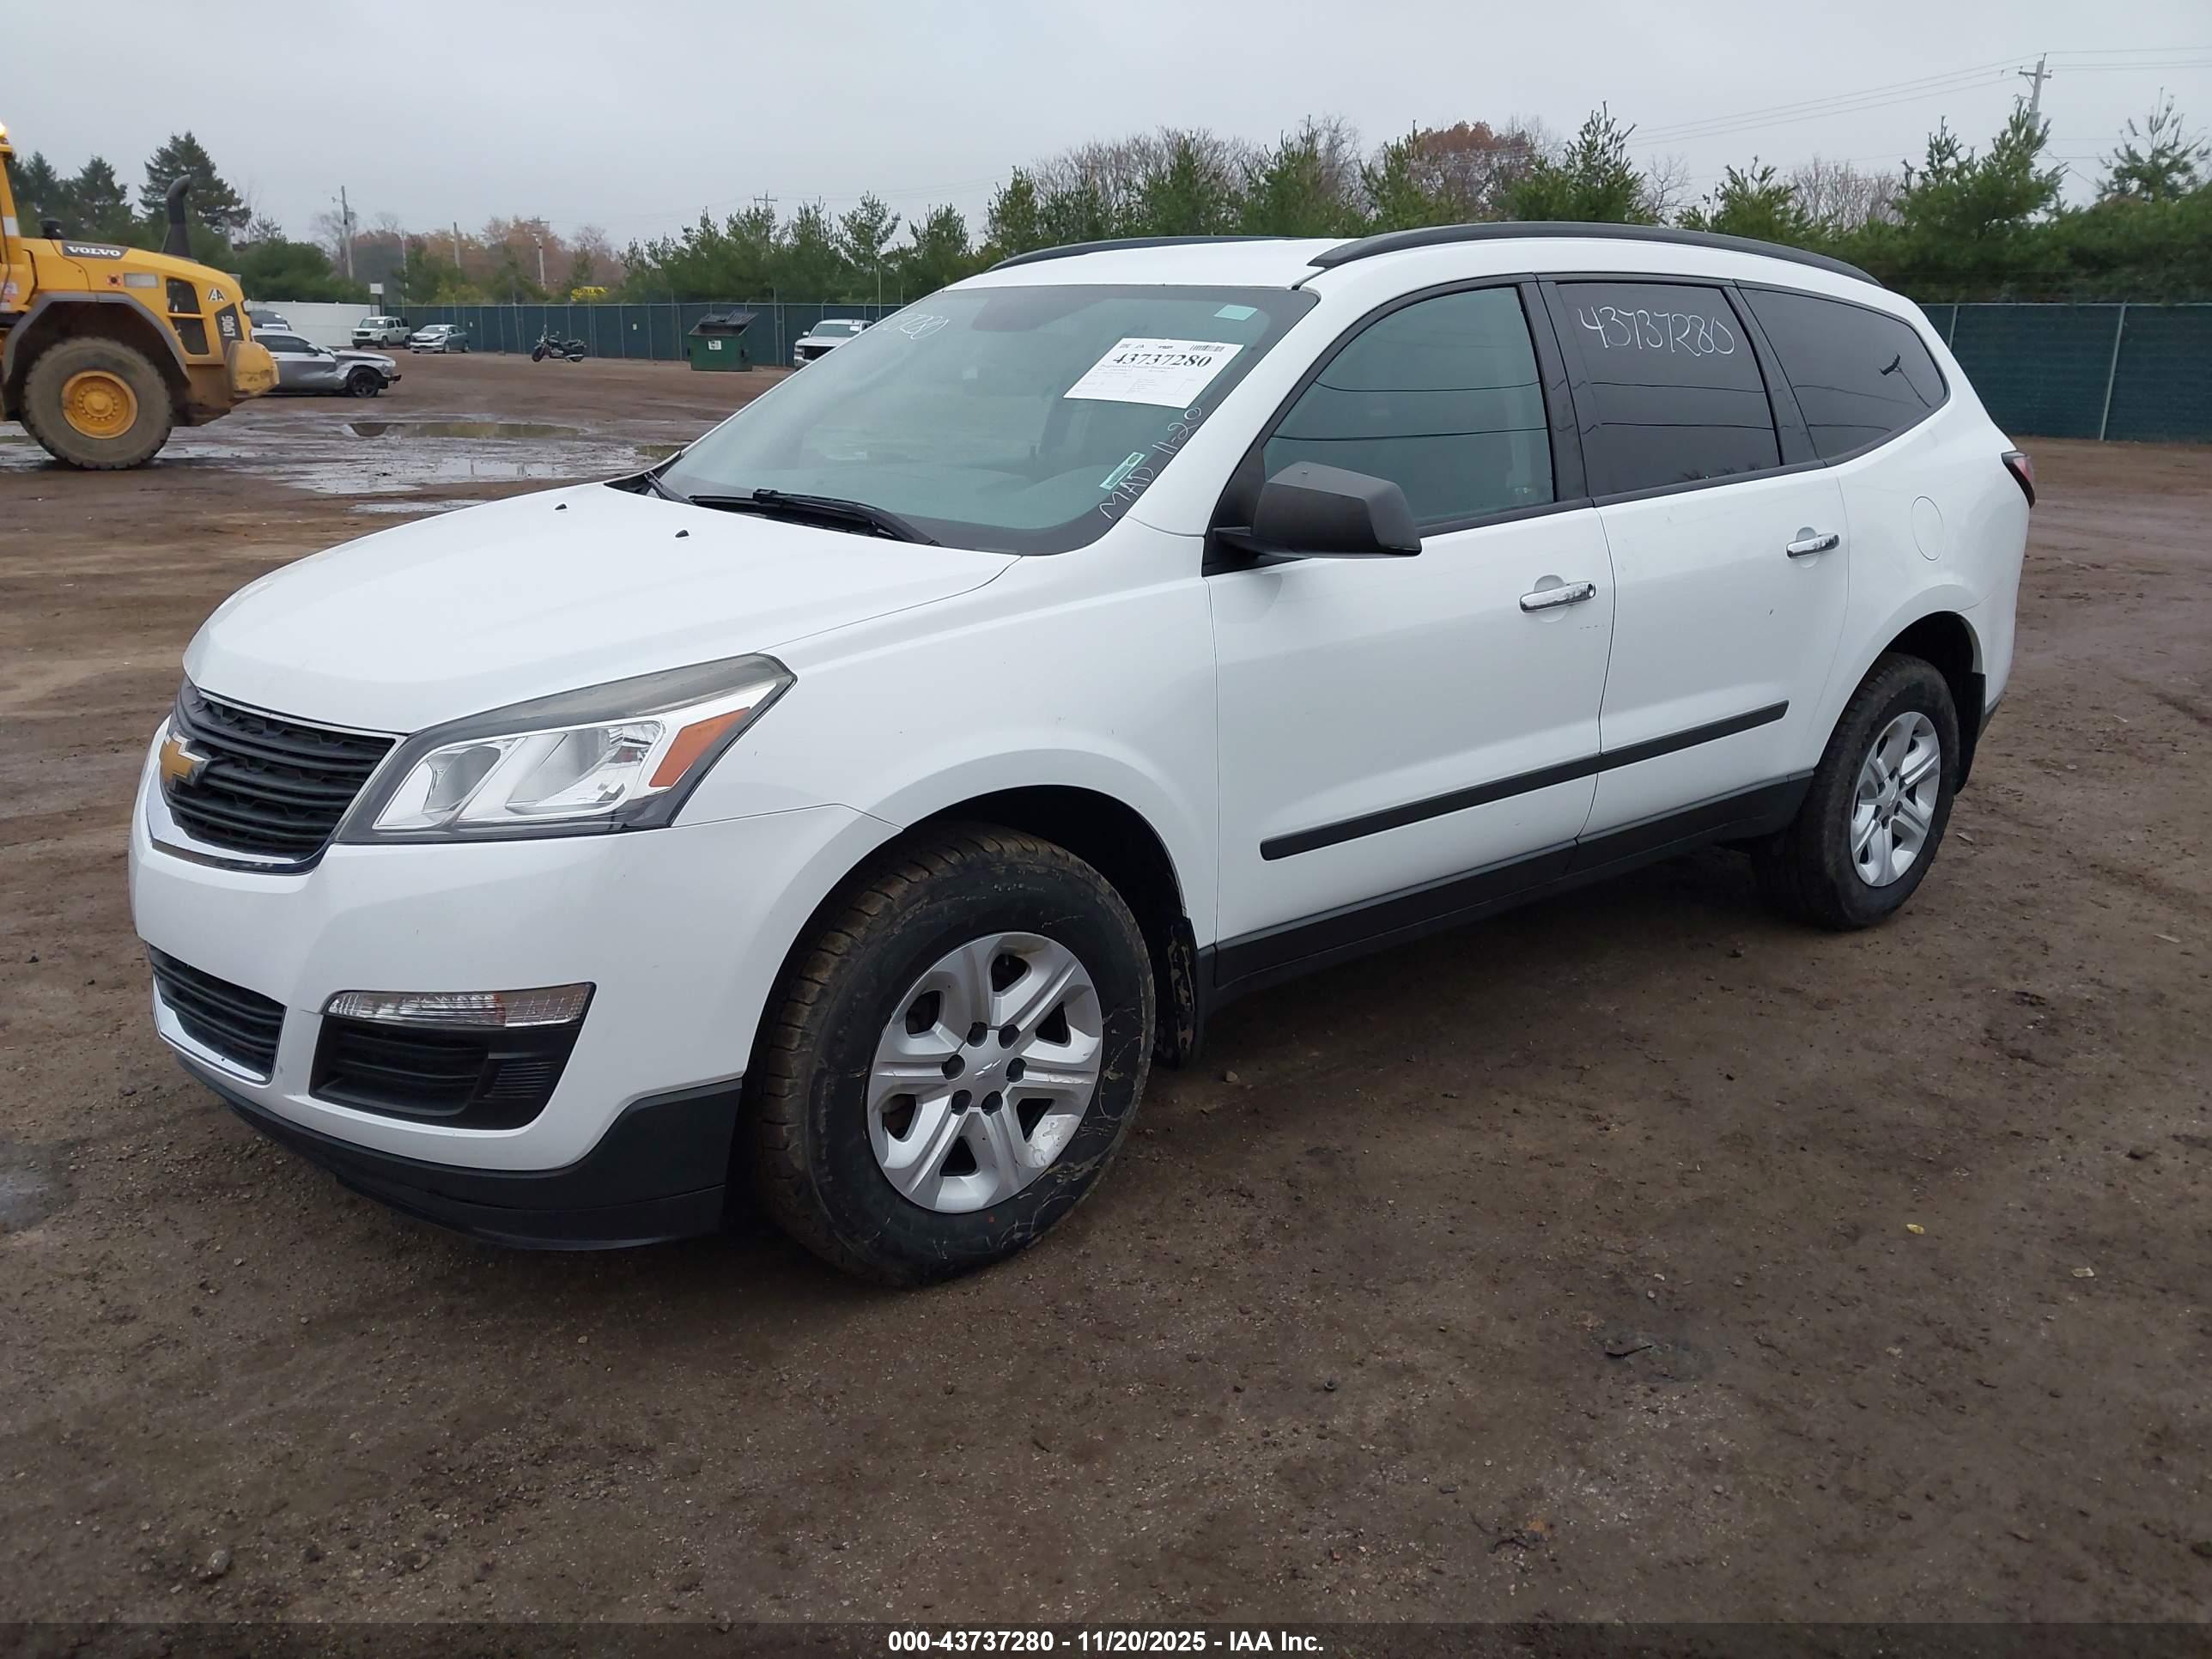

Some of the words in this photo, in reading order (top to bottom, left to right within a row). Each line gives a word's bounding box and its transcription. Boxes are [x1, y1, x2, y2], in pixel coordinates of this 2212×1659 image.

[66, 246, 120, 257] VOLVO
[222, 315, 235, 337] L90G
[1577, 306, 1735, 356] 43737280
[1113, 352, 1212, 368] 43737280
[1099, 466, 1154, 520] MAD
